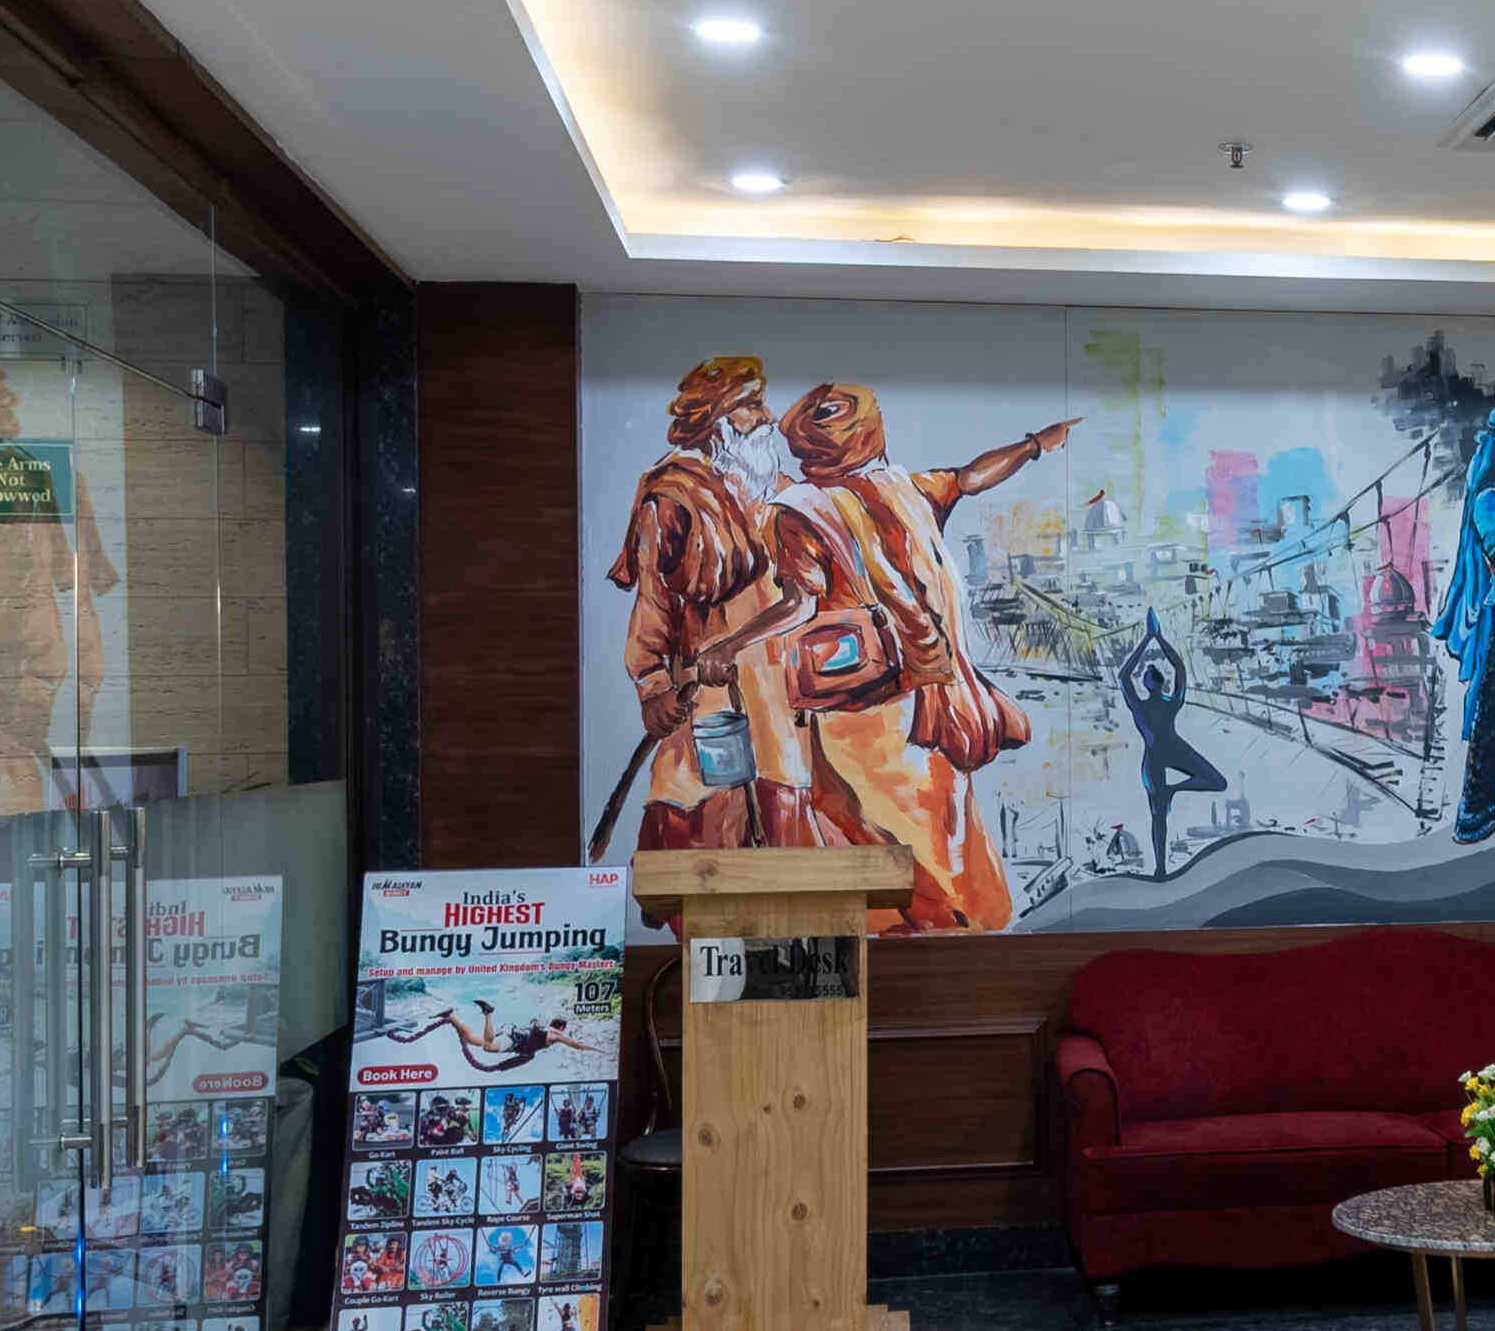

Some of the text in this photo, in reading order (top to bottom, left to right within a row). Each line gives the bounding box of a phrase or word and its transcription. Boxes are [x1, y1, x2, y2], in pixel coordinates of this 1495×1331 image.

[9, 456, 52, 471] Arms
[462, 888, 526, 905] India's
[443, 901, 546, 928] HIGHEST
[379, 922, 607, 958] Bungy Jumping
[368, 967, 394, 979] Setup
[396, 966, 414, 976] and
[455, 965, 466, 977] by
[574, 981, 618, 1003] 107
[575, 1005, 611, 1014] Meters
[362, 1068, 433, 1082] Book Here
